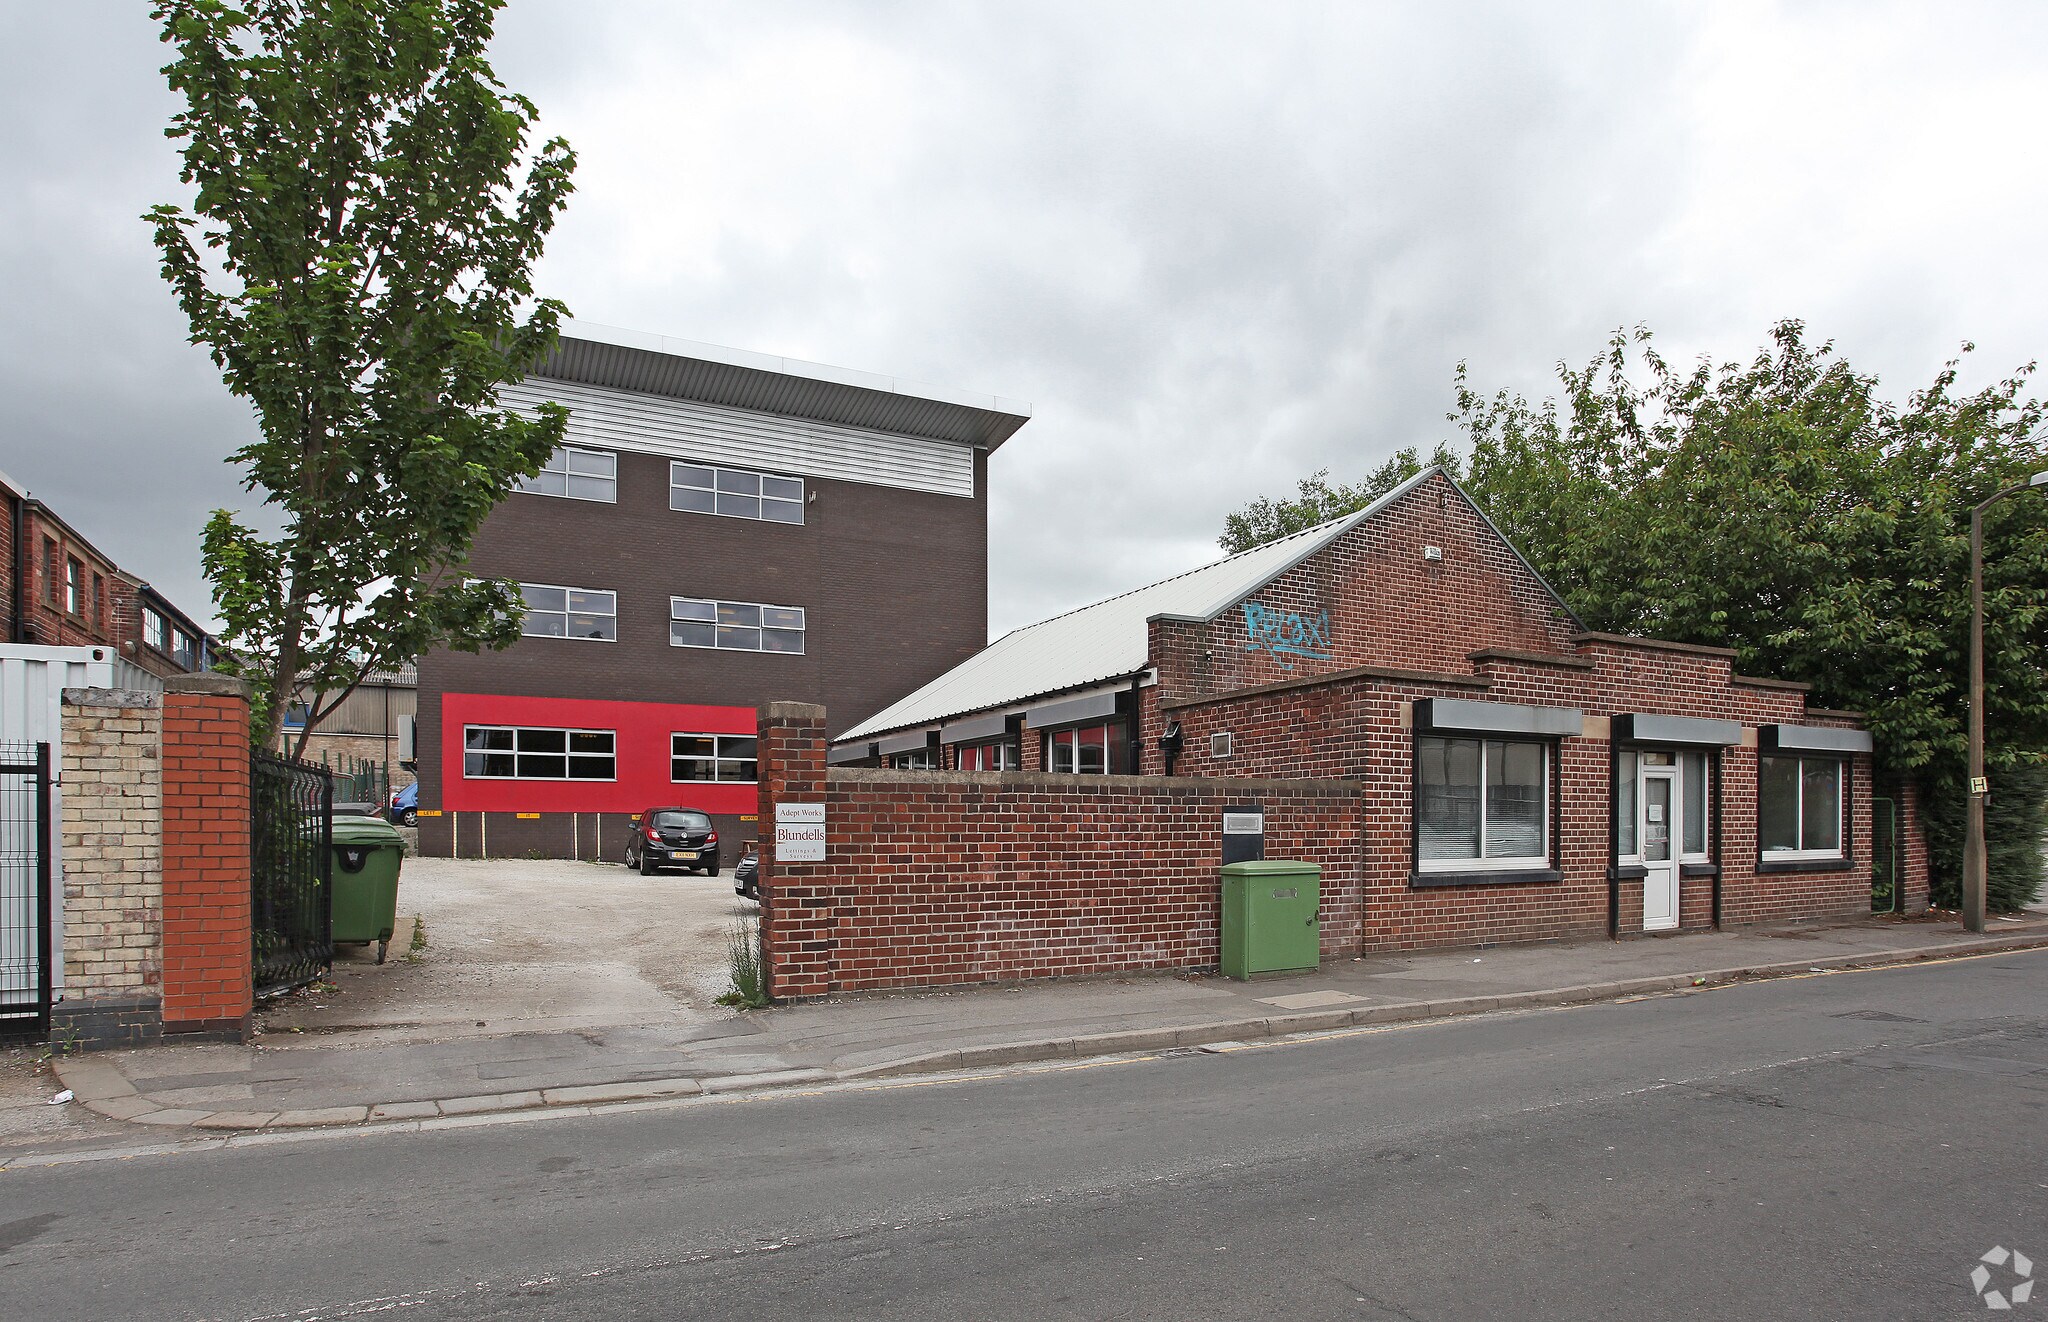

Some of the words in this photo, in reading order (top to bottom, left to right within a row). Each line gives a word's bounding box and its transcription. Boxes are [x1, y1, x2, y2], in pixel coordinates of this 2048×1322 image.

[1973, 778, 1985, 791] H
[780, 809, 800, 818] Adept
[801, 809, 823, 817] Works
[778, 828, 824, 840] Blundells
